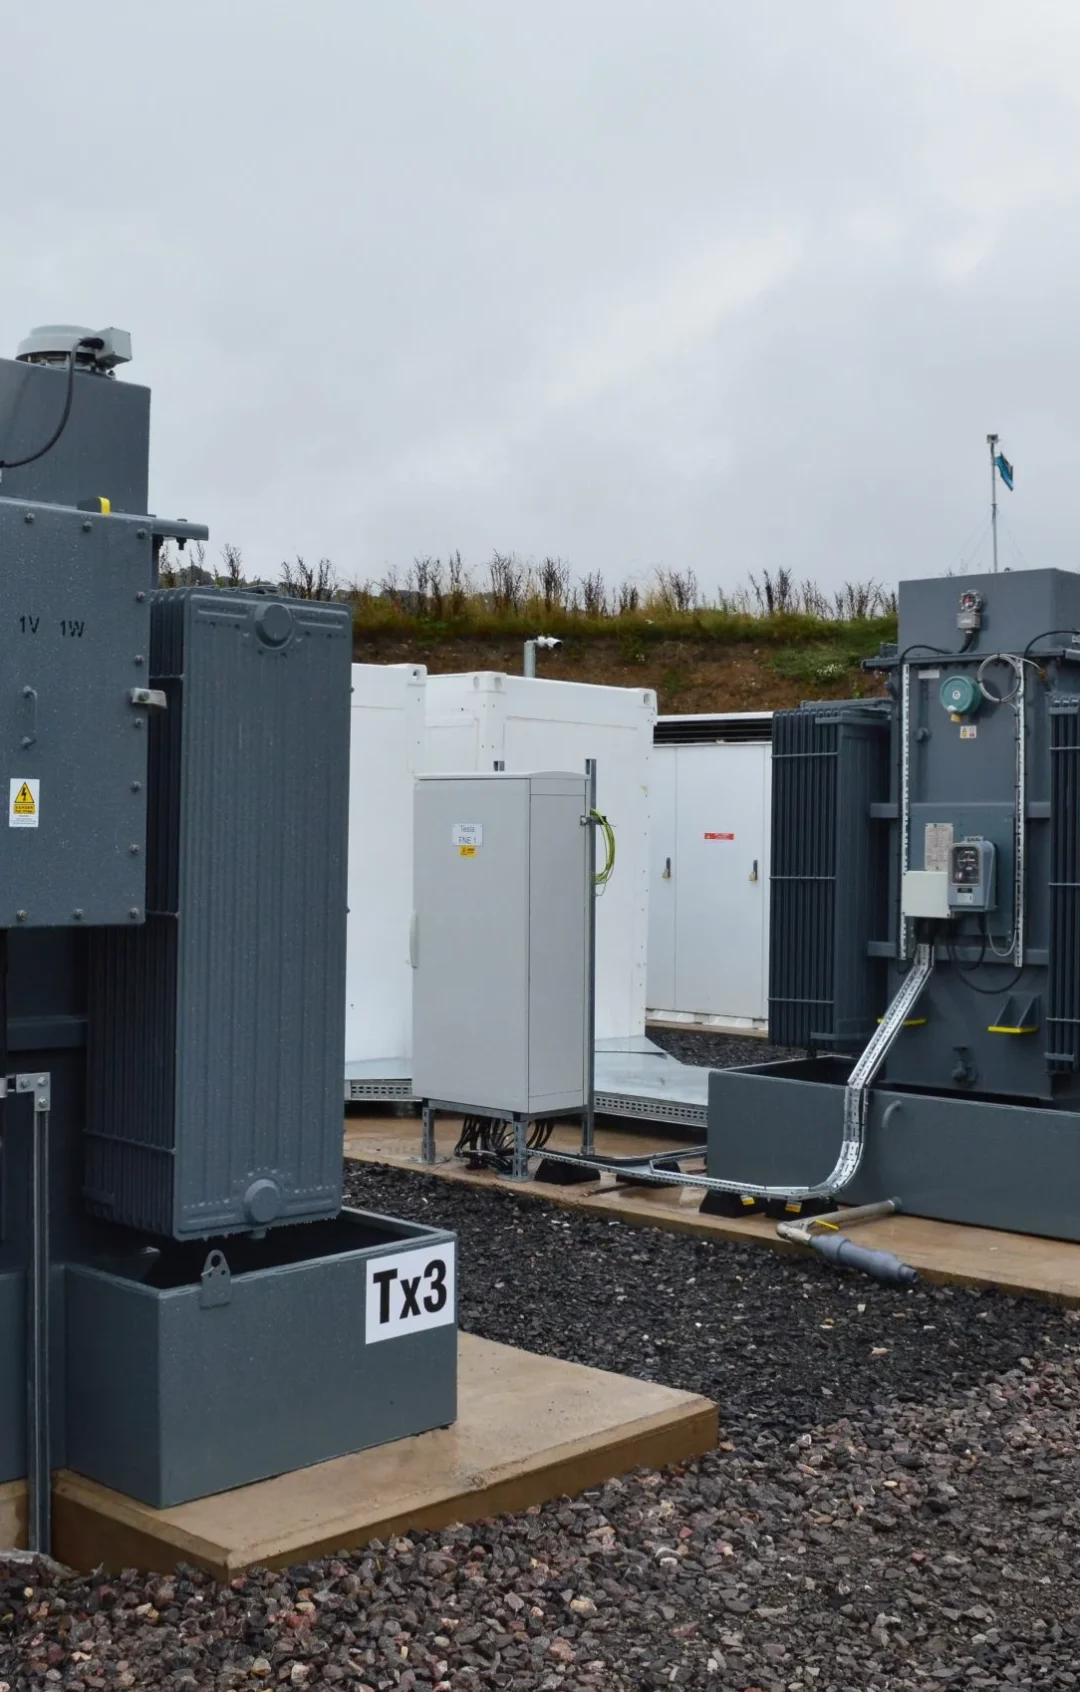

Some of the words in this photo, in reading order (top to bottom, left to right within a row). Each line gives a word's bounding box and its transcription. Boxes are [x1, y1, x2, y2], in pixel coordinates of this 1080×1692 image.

[20, 616, 40, 634] 1V
[60, 620, 85, 637] 1W
[373, 1259, 448, 1325] Tx3
